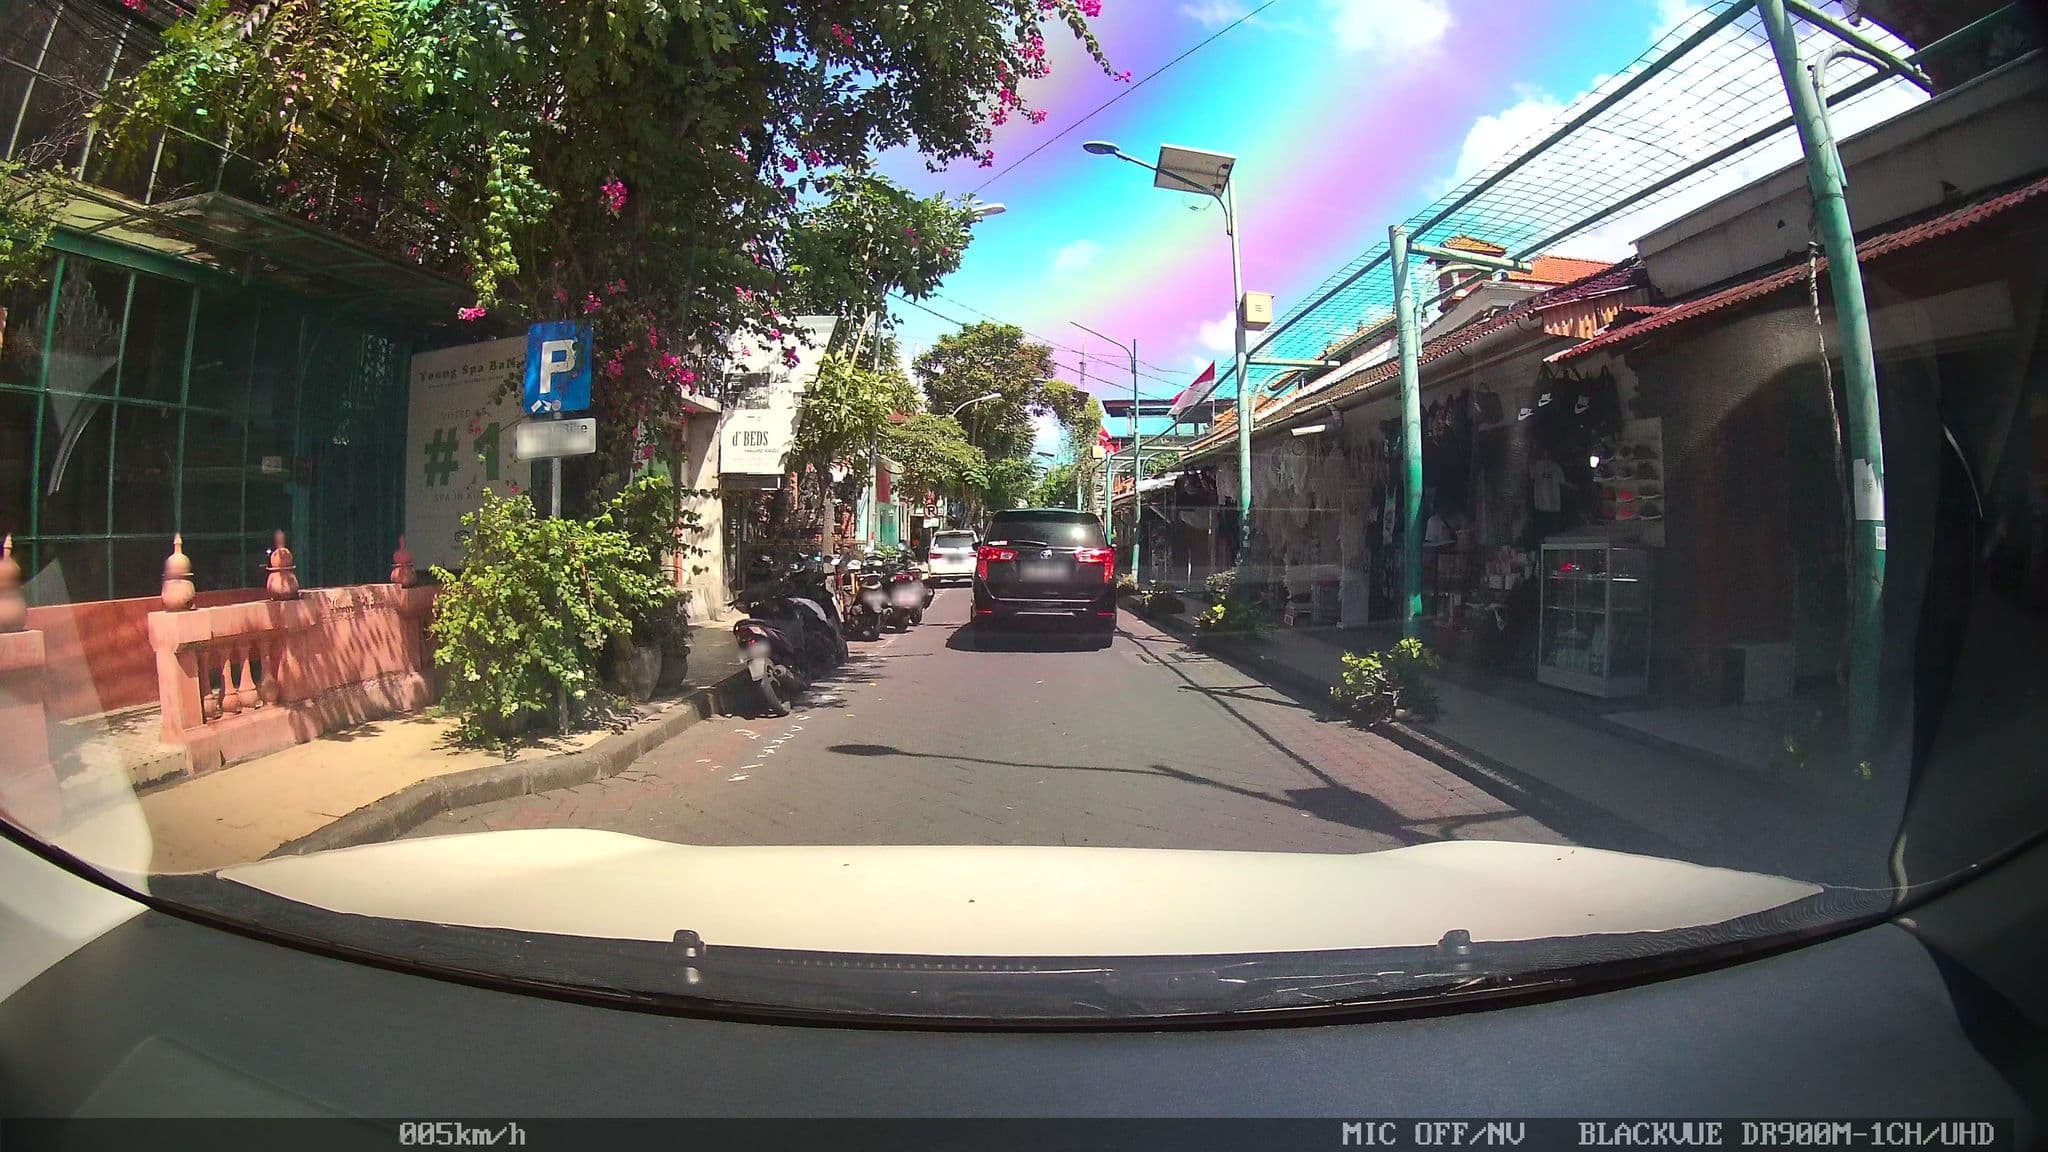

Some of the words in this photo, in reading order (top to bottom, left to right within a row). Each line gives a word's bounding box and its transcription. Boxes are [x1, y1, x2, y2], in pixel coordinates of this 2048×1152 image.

[462, 363, 484, 376] Spa
[539, 339, 577, 394] P
[743, 431, 769, 447] BEDS
